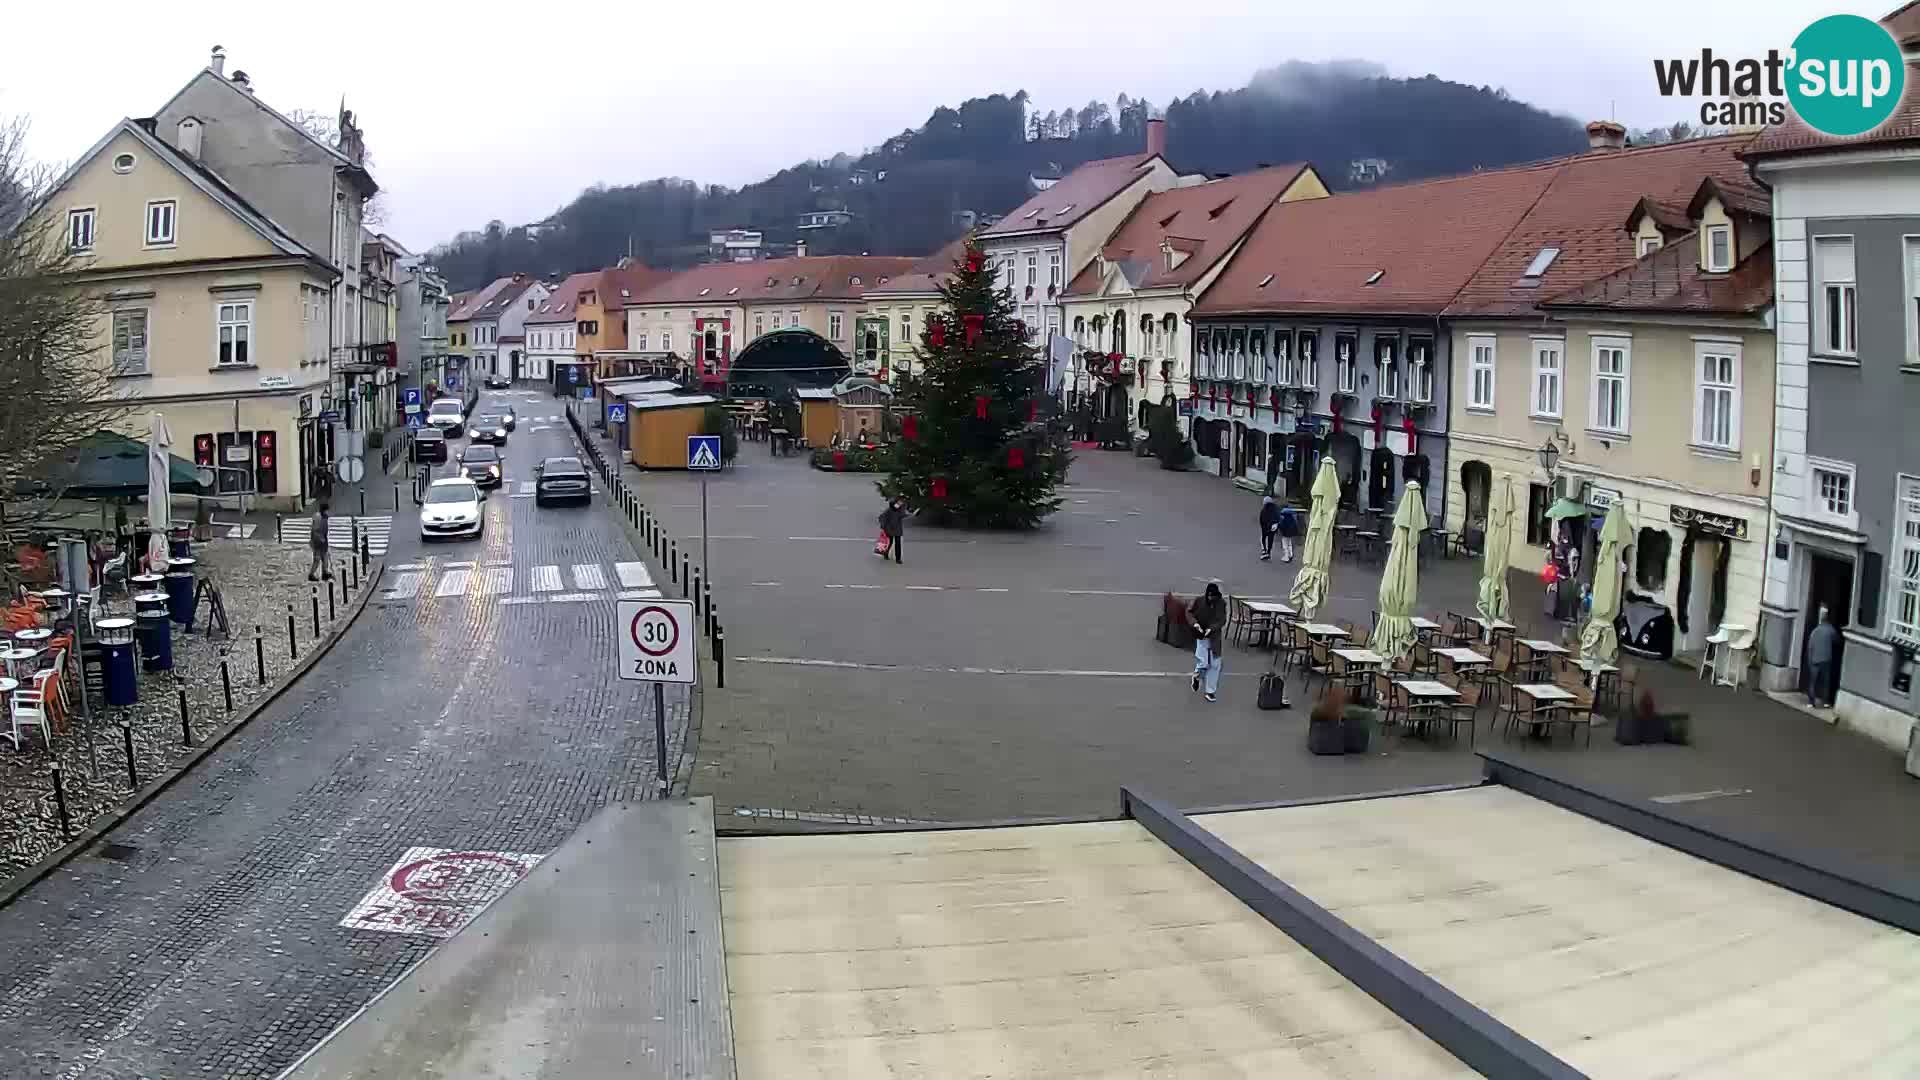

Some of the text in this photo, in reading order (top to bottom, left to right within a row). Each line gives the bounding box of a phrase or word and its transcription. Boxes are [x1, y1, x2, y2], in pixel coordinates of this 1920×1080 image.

[408, 391, 417, 403] P
[643, 622, 668, 643] 30
[634, 659, 679, 676] ZONA
